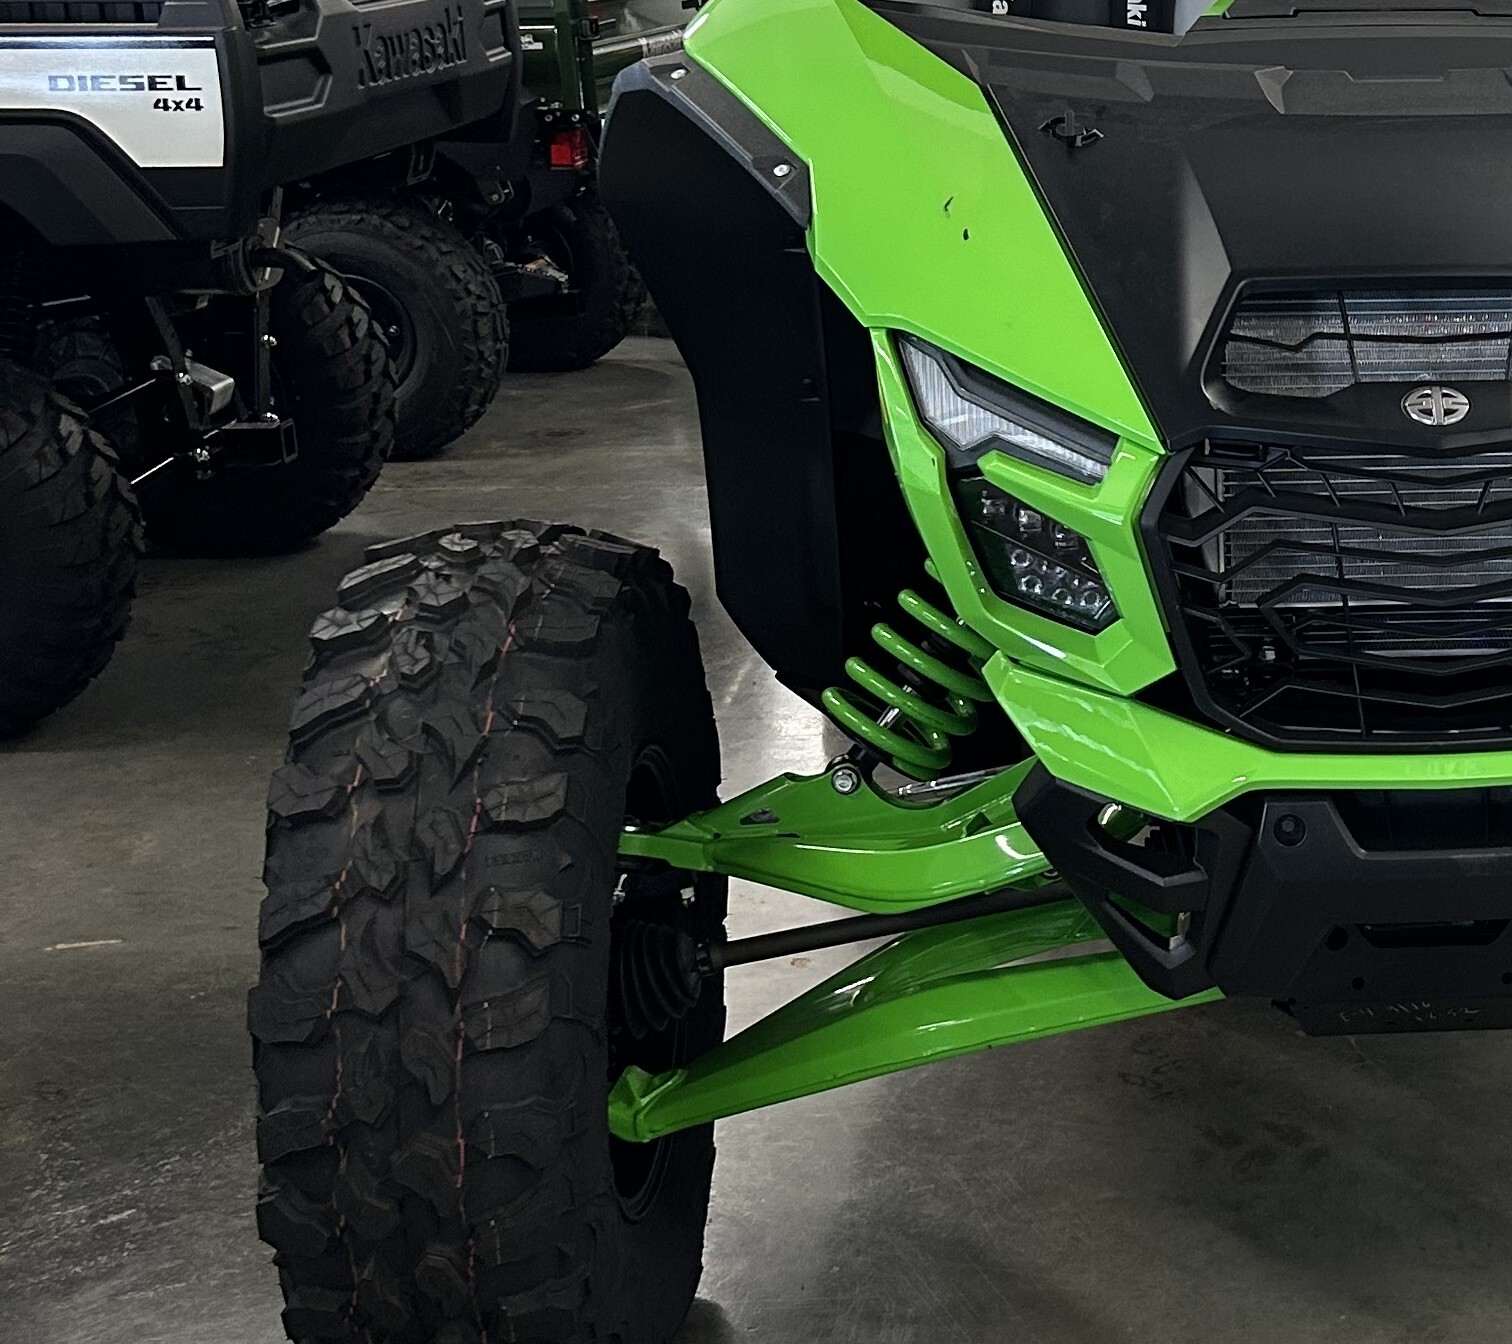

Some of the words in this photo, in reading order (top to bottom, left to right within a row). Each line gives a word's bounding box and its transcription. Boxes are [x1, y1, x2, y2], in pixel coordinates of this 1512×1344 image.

[352, 5, 468, 89] Kawasaki
[48, 75, 203, 92] DIESEL
[153, 98, 204, 112] 4x4
